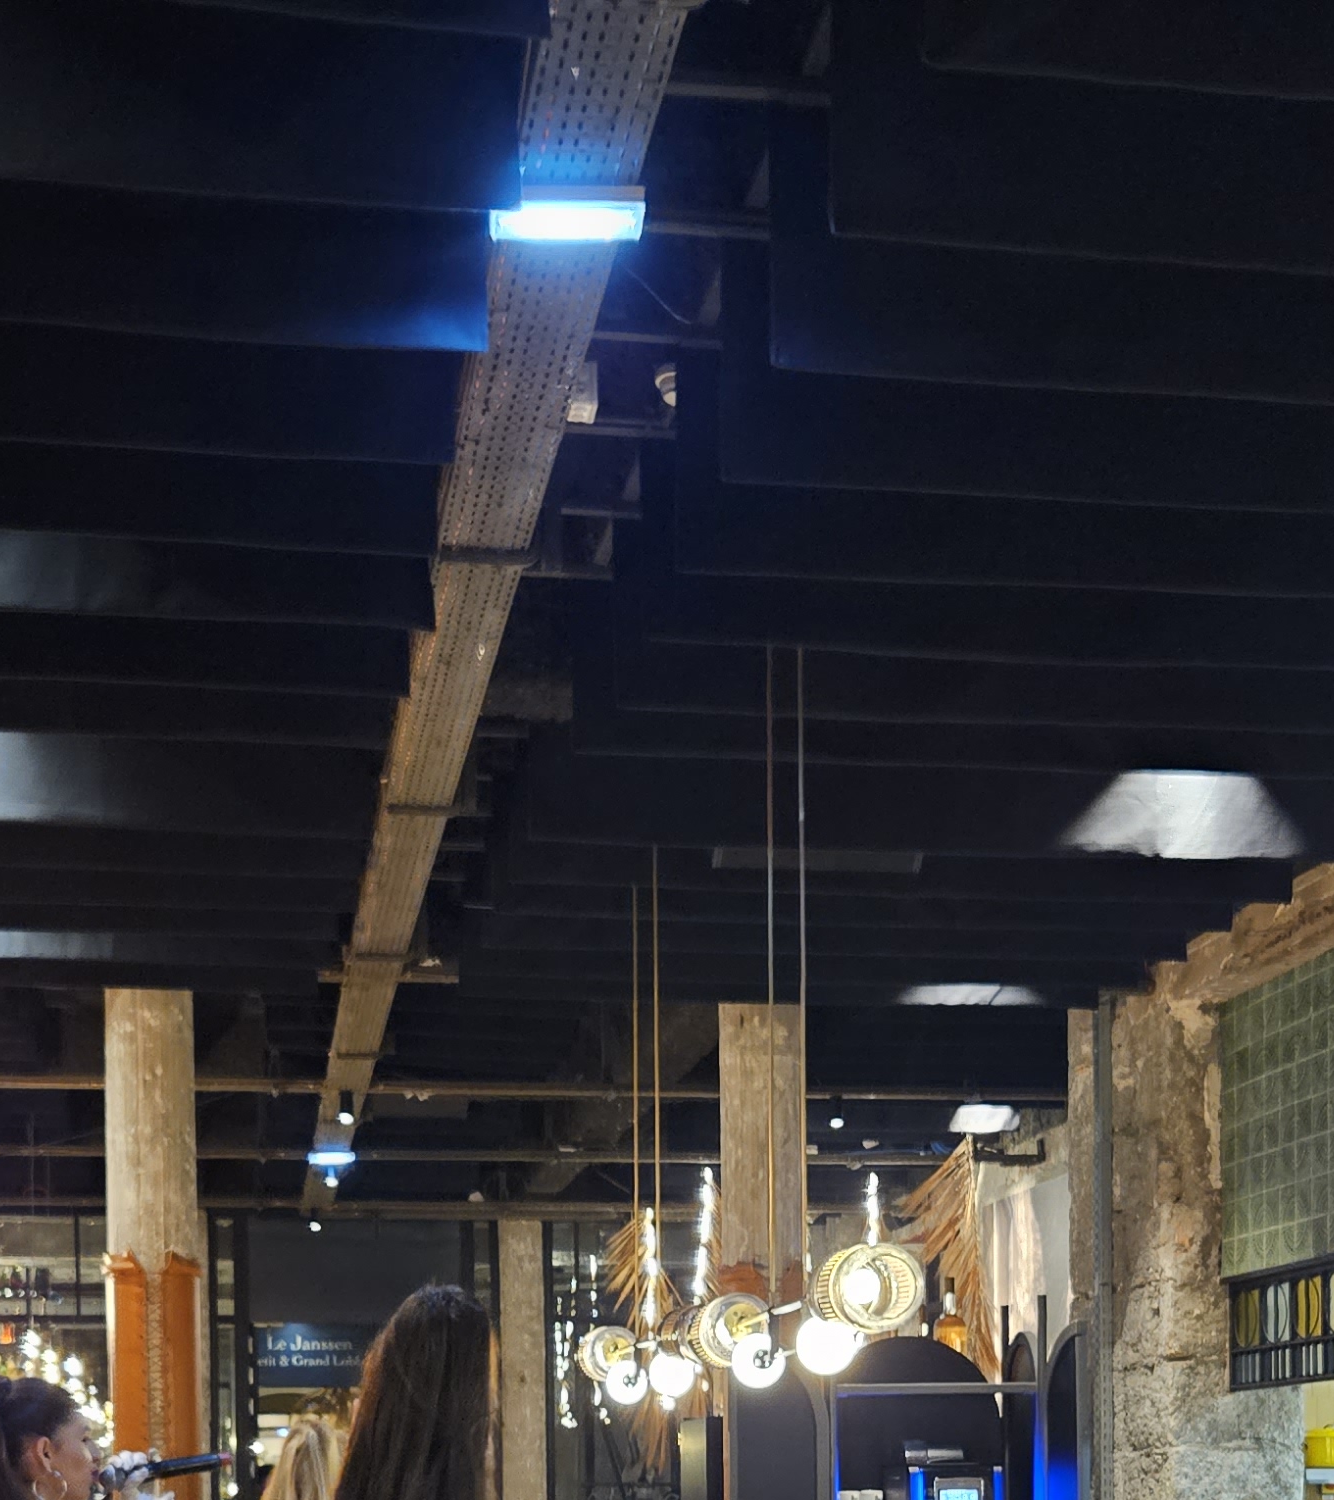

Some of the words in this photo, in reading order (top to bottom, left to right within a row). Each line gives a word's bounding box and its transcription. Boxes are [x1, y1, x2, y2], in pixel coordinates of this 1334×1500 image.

[266, 1333, 287, 1351] Le
[290, 1333, 353, 1351] Janssen
[257, 1355, 276, 1367] etit
[278, 1354, 290, 1367] &
[291, 1354, 331, 1367] Grand
